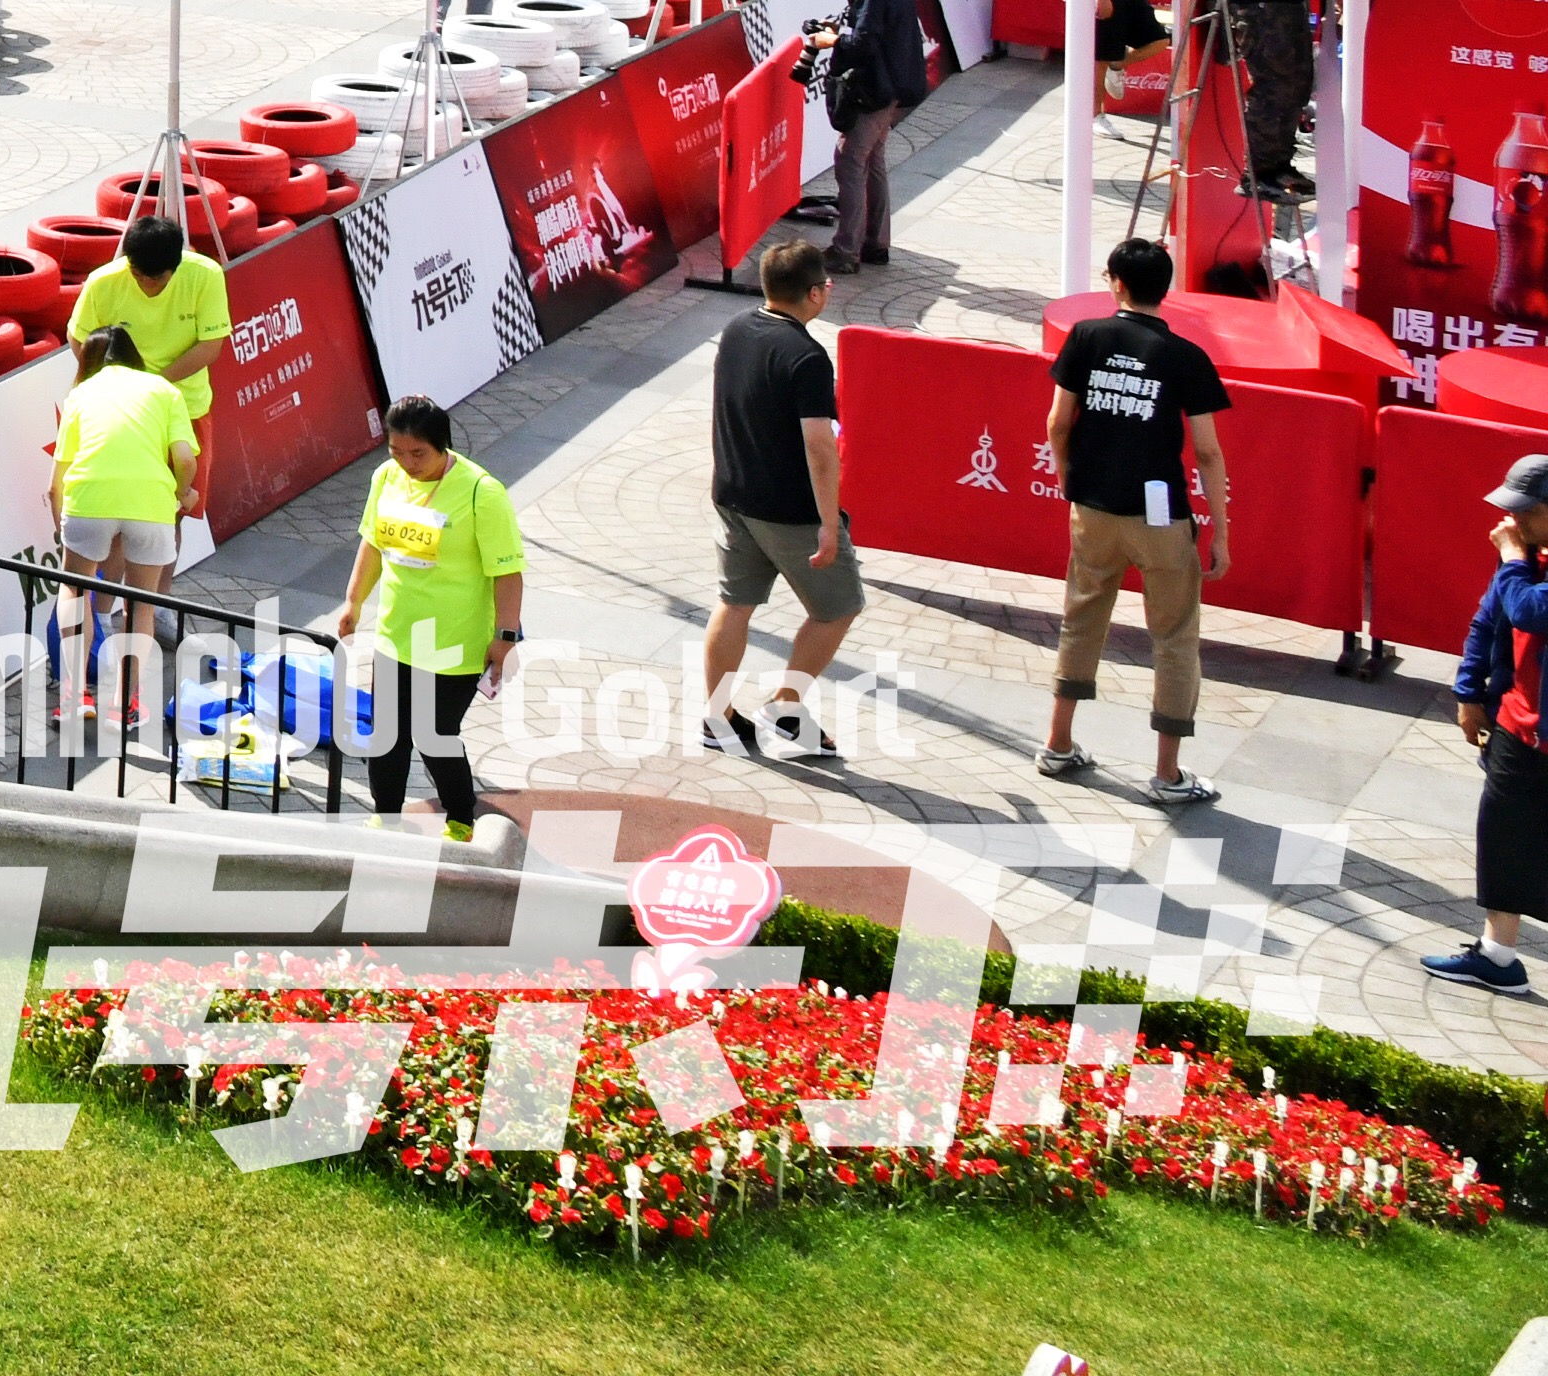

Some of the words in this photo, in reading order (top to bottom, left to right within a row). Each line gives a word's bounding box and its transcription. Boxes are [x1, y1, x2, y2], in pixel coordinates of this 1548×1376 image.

[1450, 45, 1514, 71] 这感觉
[413, 256, 435, 281] ninebot
[411, 262, 468, 332] 九号卡丁
[1088, 369, 1162, 400] 潮酷随我
[379, 520, 397, 537] 36
[399, 524, 434, 547] 0243
